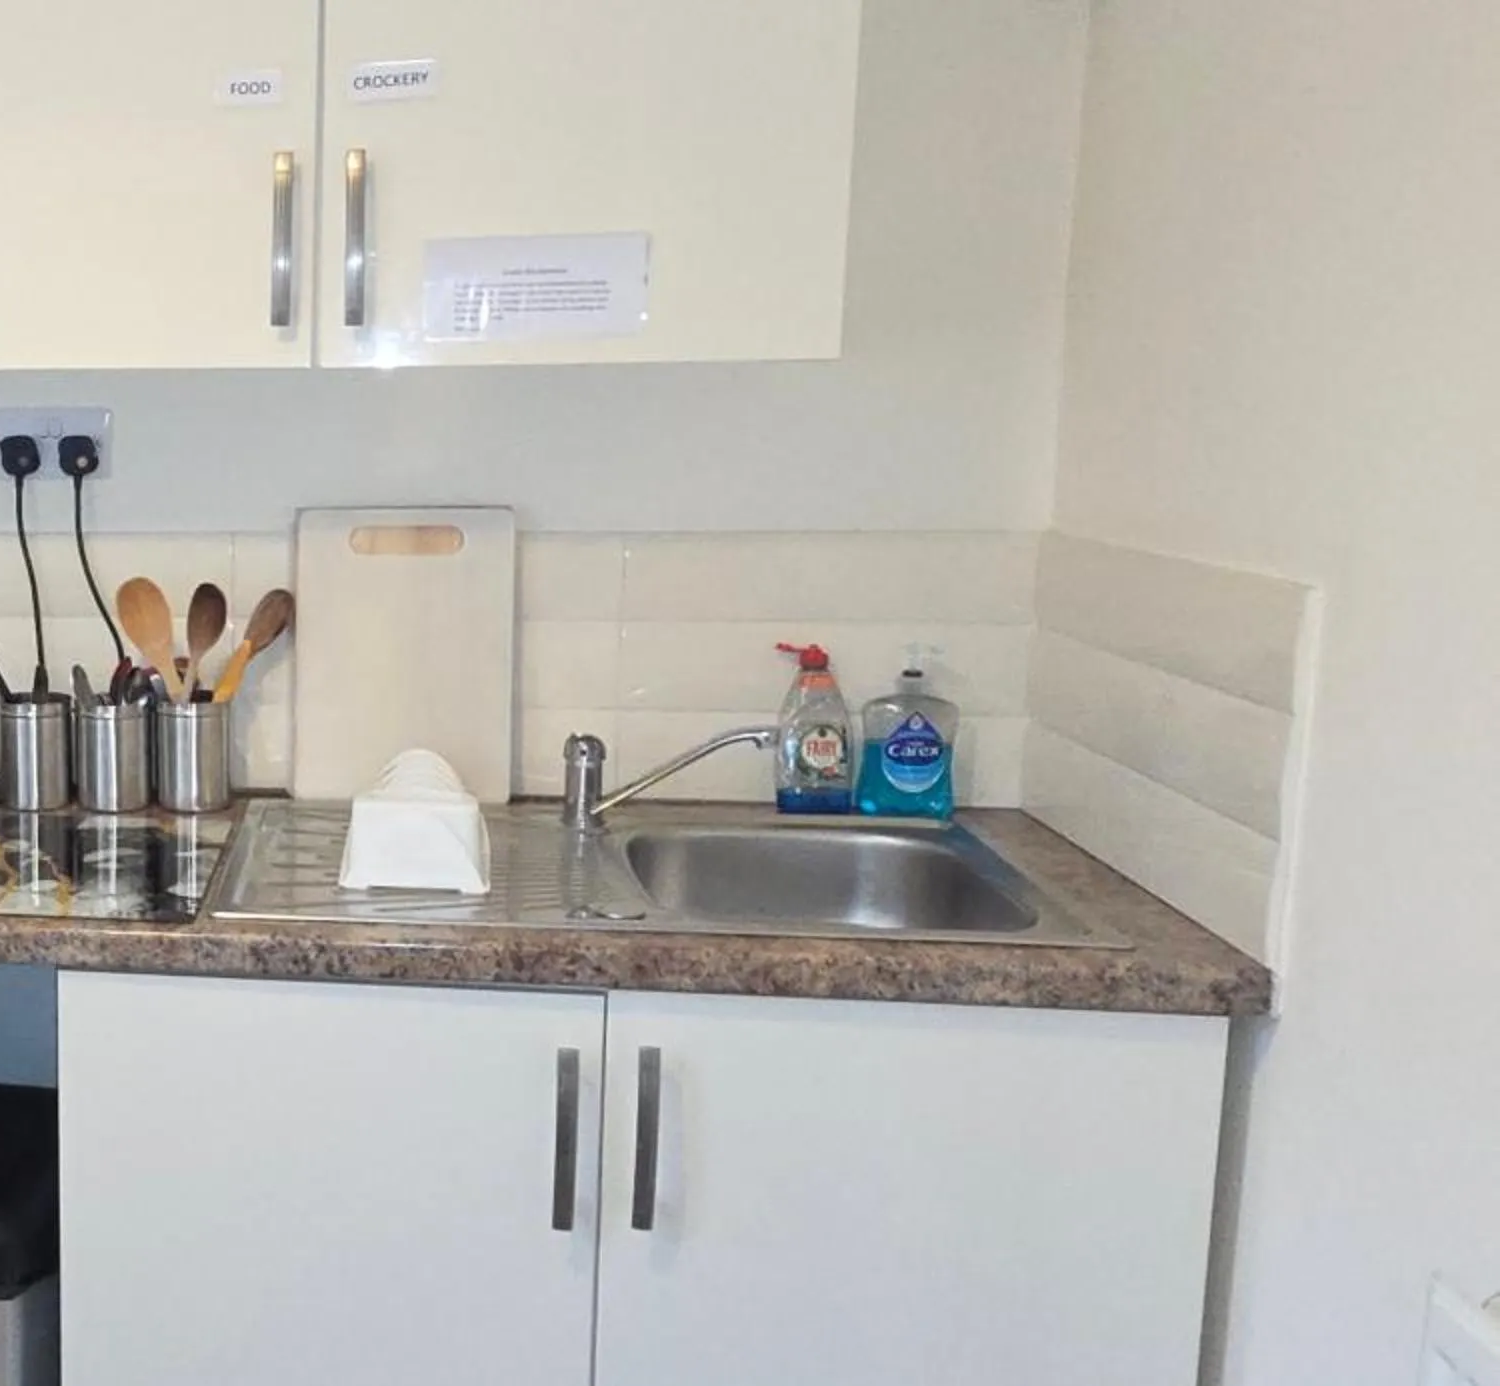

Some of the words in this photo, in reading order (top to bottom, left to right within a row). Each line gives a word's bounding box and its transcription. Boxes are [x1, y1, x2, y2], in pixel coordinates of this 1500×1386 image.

[353, 71, 429, 90] CROCKERY
[230, 81, 271, 95] FOOD
[887, 743, 939, 757] Carex
